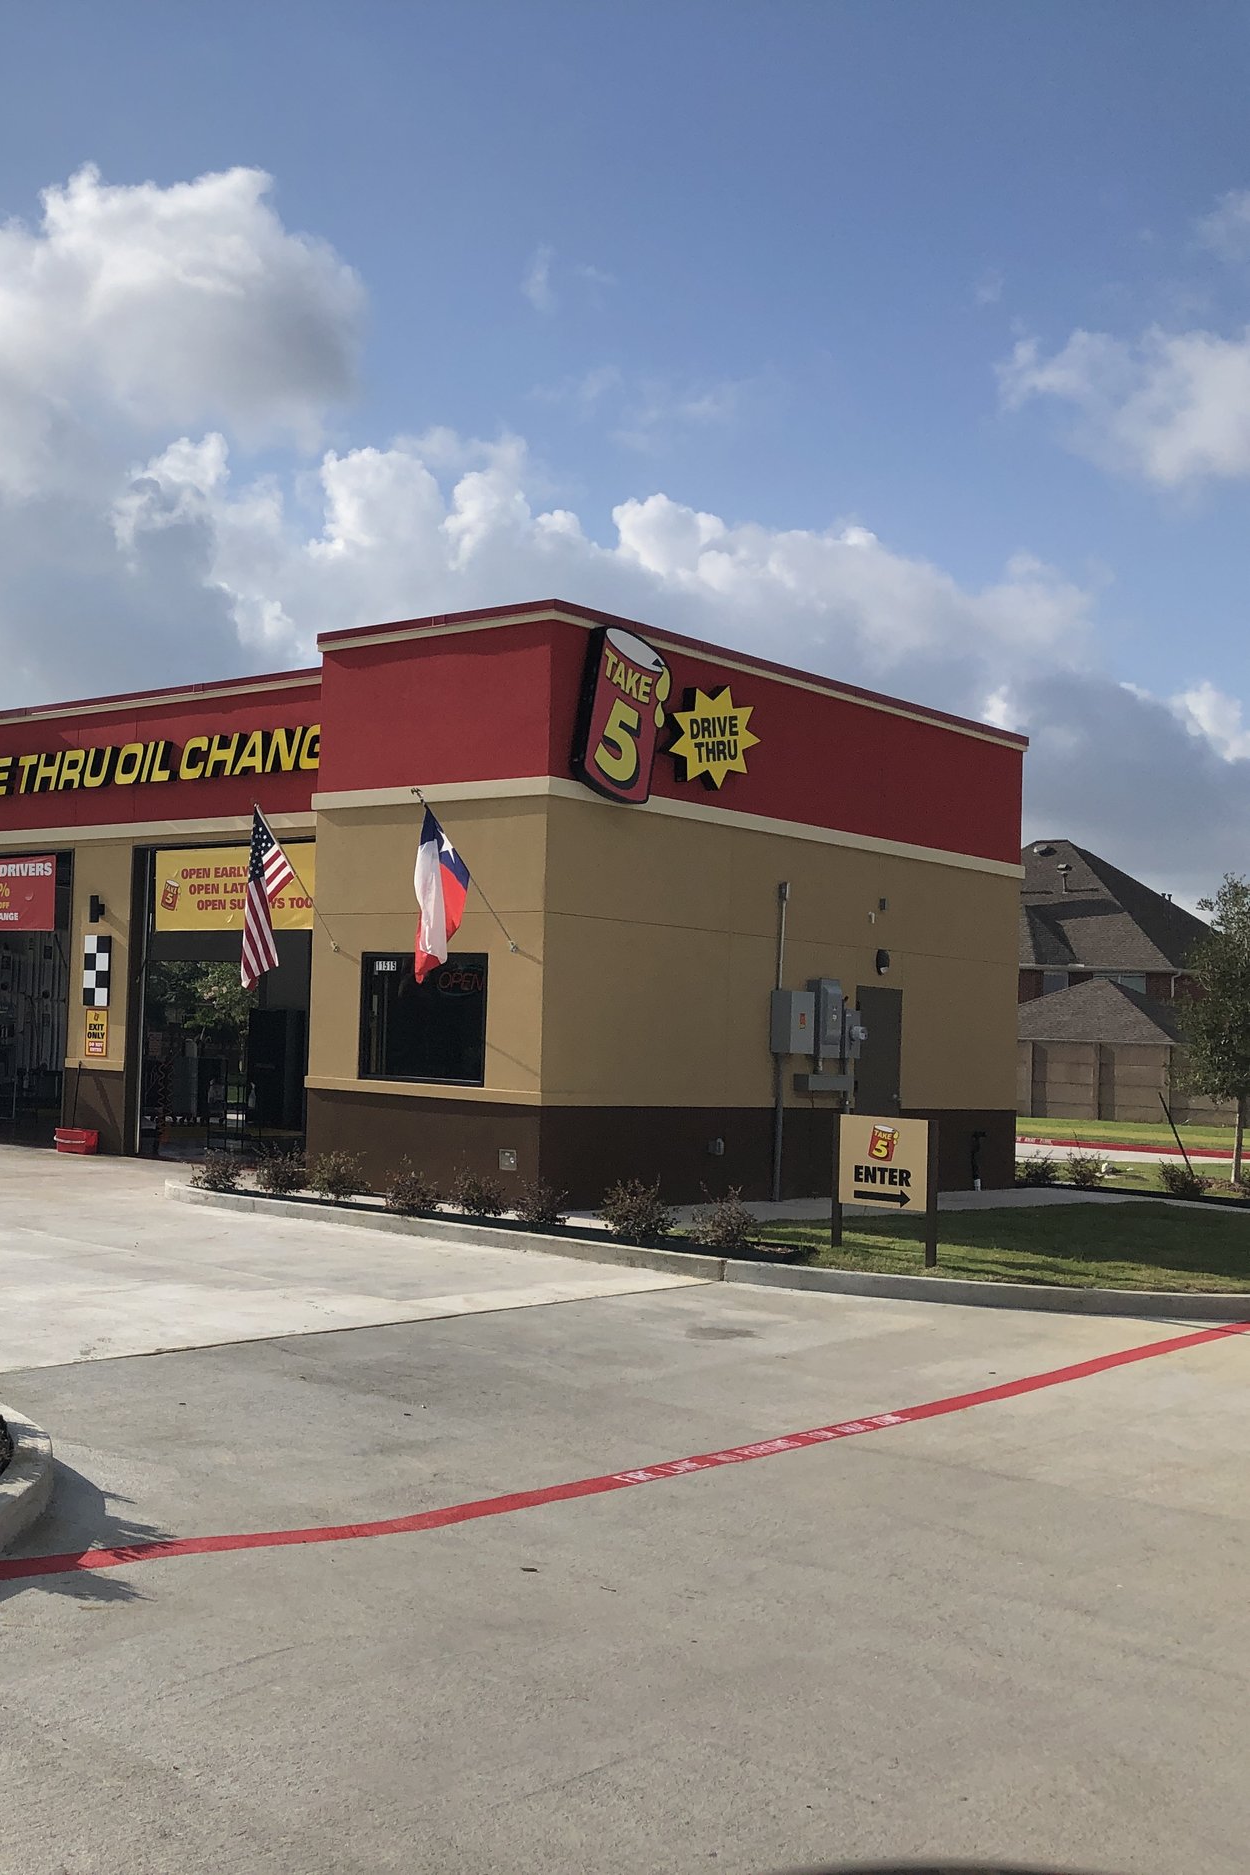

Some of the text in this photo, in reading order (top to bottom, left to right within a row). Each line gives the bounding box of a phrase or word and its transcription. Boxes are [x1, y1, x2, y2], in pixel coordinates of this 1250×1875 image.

[605, 647, 653, 703] TAKE
[689, 715, 740, 740] DRIVE
[594, 697, 640, 786] 5
[694, 739, 738, 763] THRU
[18, 745, 113, 794] THRU
[114, 740, 171, 785] OIL
[181, 868, 210, 879] OPEN
[189, 883, 249, 895] OPEN LAT
[197, 899, 226, 911] OPEN
[438, 971, 483, 991] OPEN
[87, 1031, 105, 1039] ONLY
[89, 1023, 104, 1031] EXIT
[874, 1130, 892, 1140] TAKE
[872, 1139, 888, 1158] 5
[854, 1165, 912, 1187] ENTER
